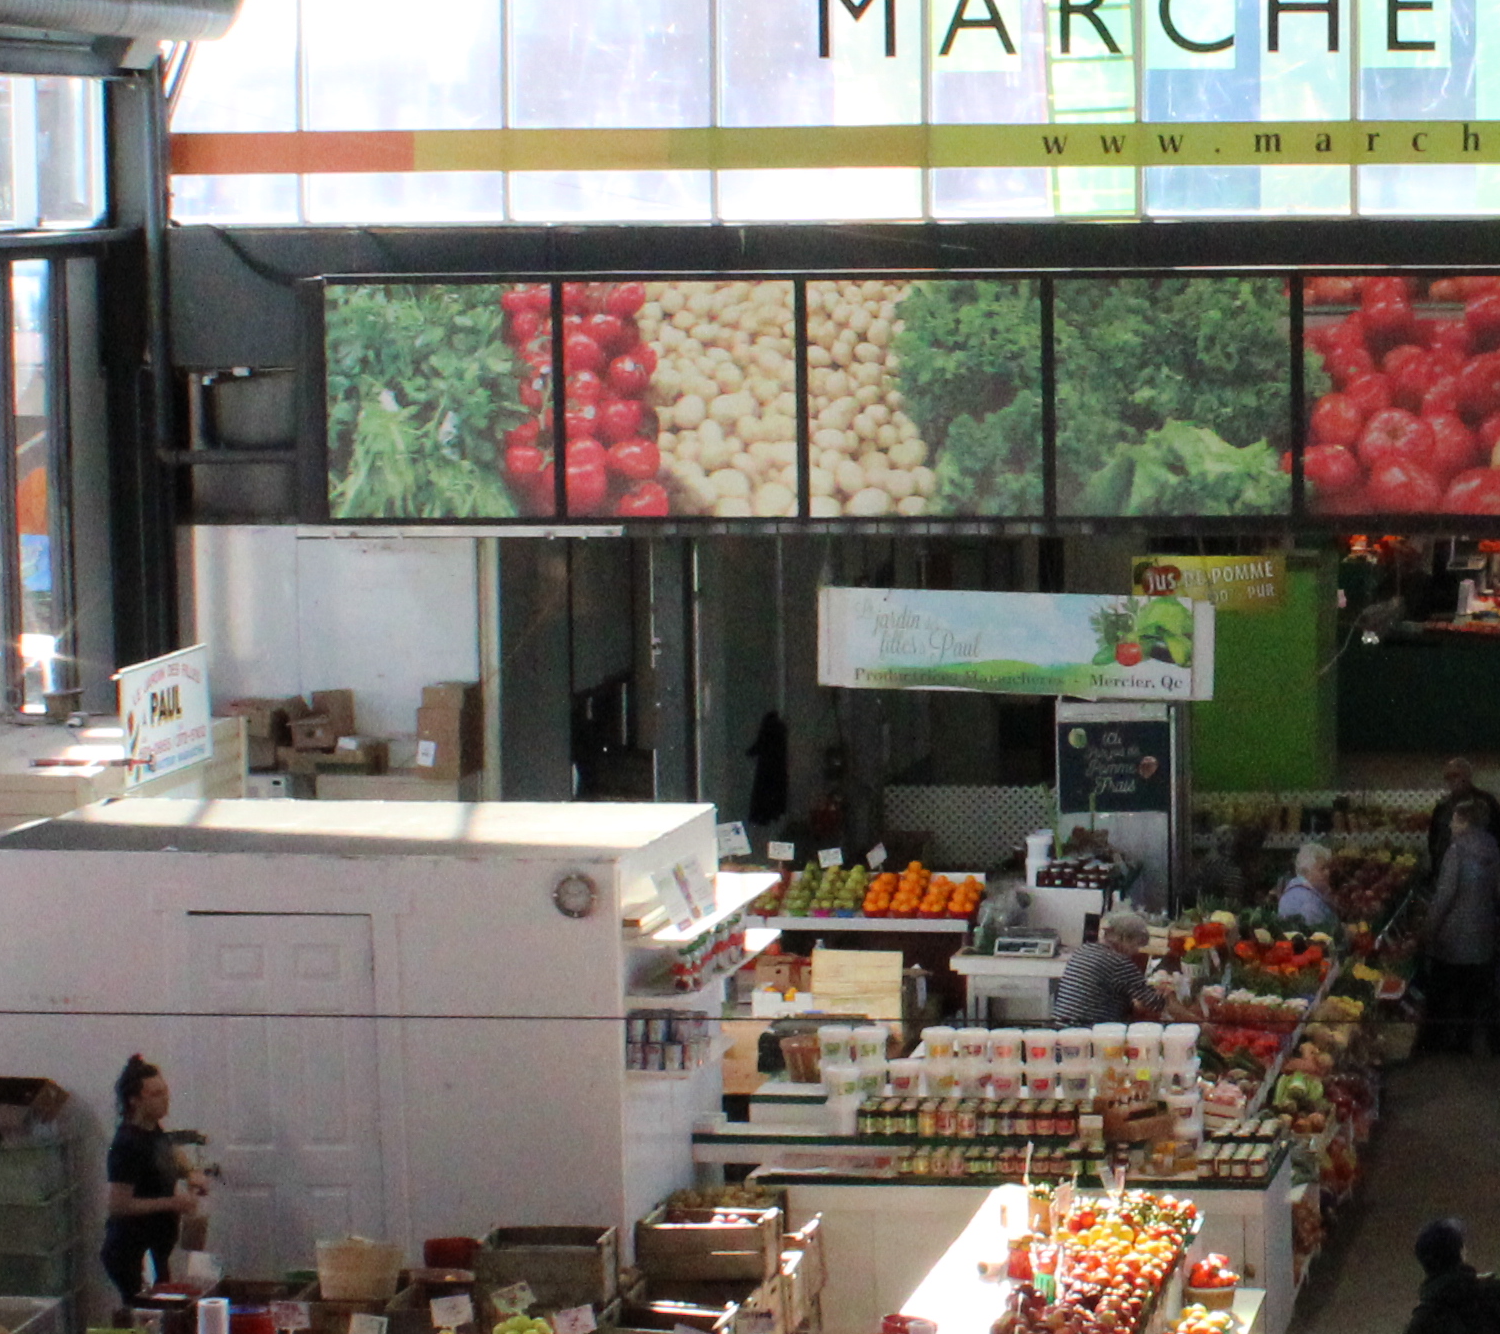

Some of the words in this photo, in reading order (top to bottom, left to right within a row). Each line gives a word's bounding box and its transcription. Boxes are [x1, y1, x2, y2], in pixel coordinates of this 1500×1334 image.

[1146, 572, 1177, 594] JUS
[1211, 560, 1274, 583] POMME
[1247, 583, 1275, 599] PUR
[928, 627, 983, 665] Paul
[1088, 673, 1155, 691] Mercier,
[1160, 674, 1184, 691] Qc
[150, 683, 183, 727] PAUL
